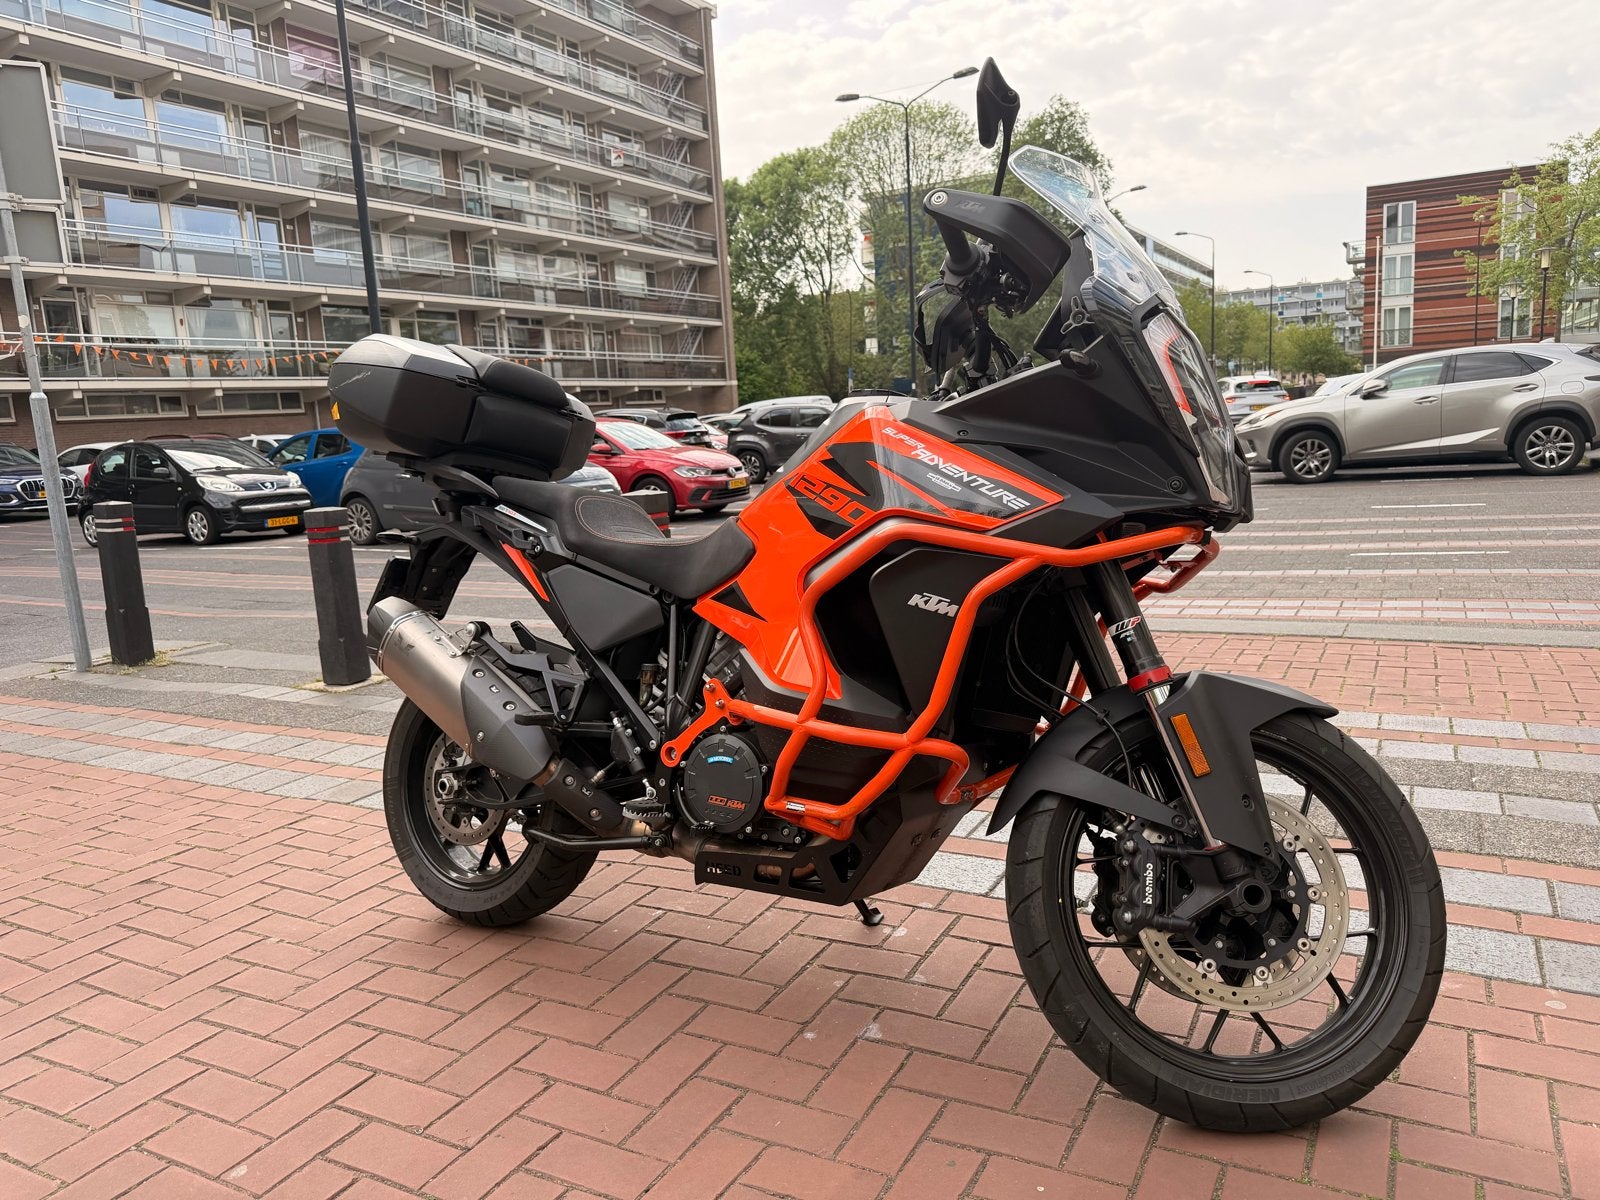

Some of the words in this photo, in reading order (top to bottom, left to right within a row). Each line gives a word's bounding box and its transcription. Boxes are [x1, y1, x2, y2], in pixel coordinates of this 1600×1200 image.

[881, 426, 926, 449] SUPER
[790, 473, 869, 526] 1290
[911, 447, 1031, 510] ADVENTURE
[907, 592, 959, 618] KTM
[1142, 862, 1154, 905] brembo
